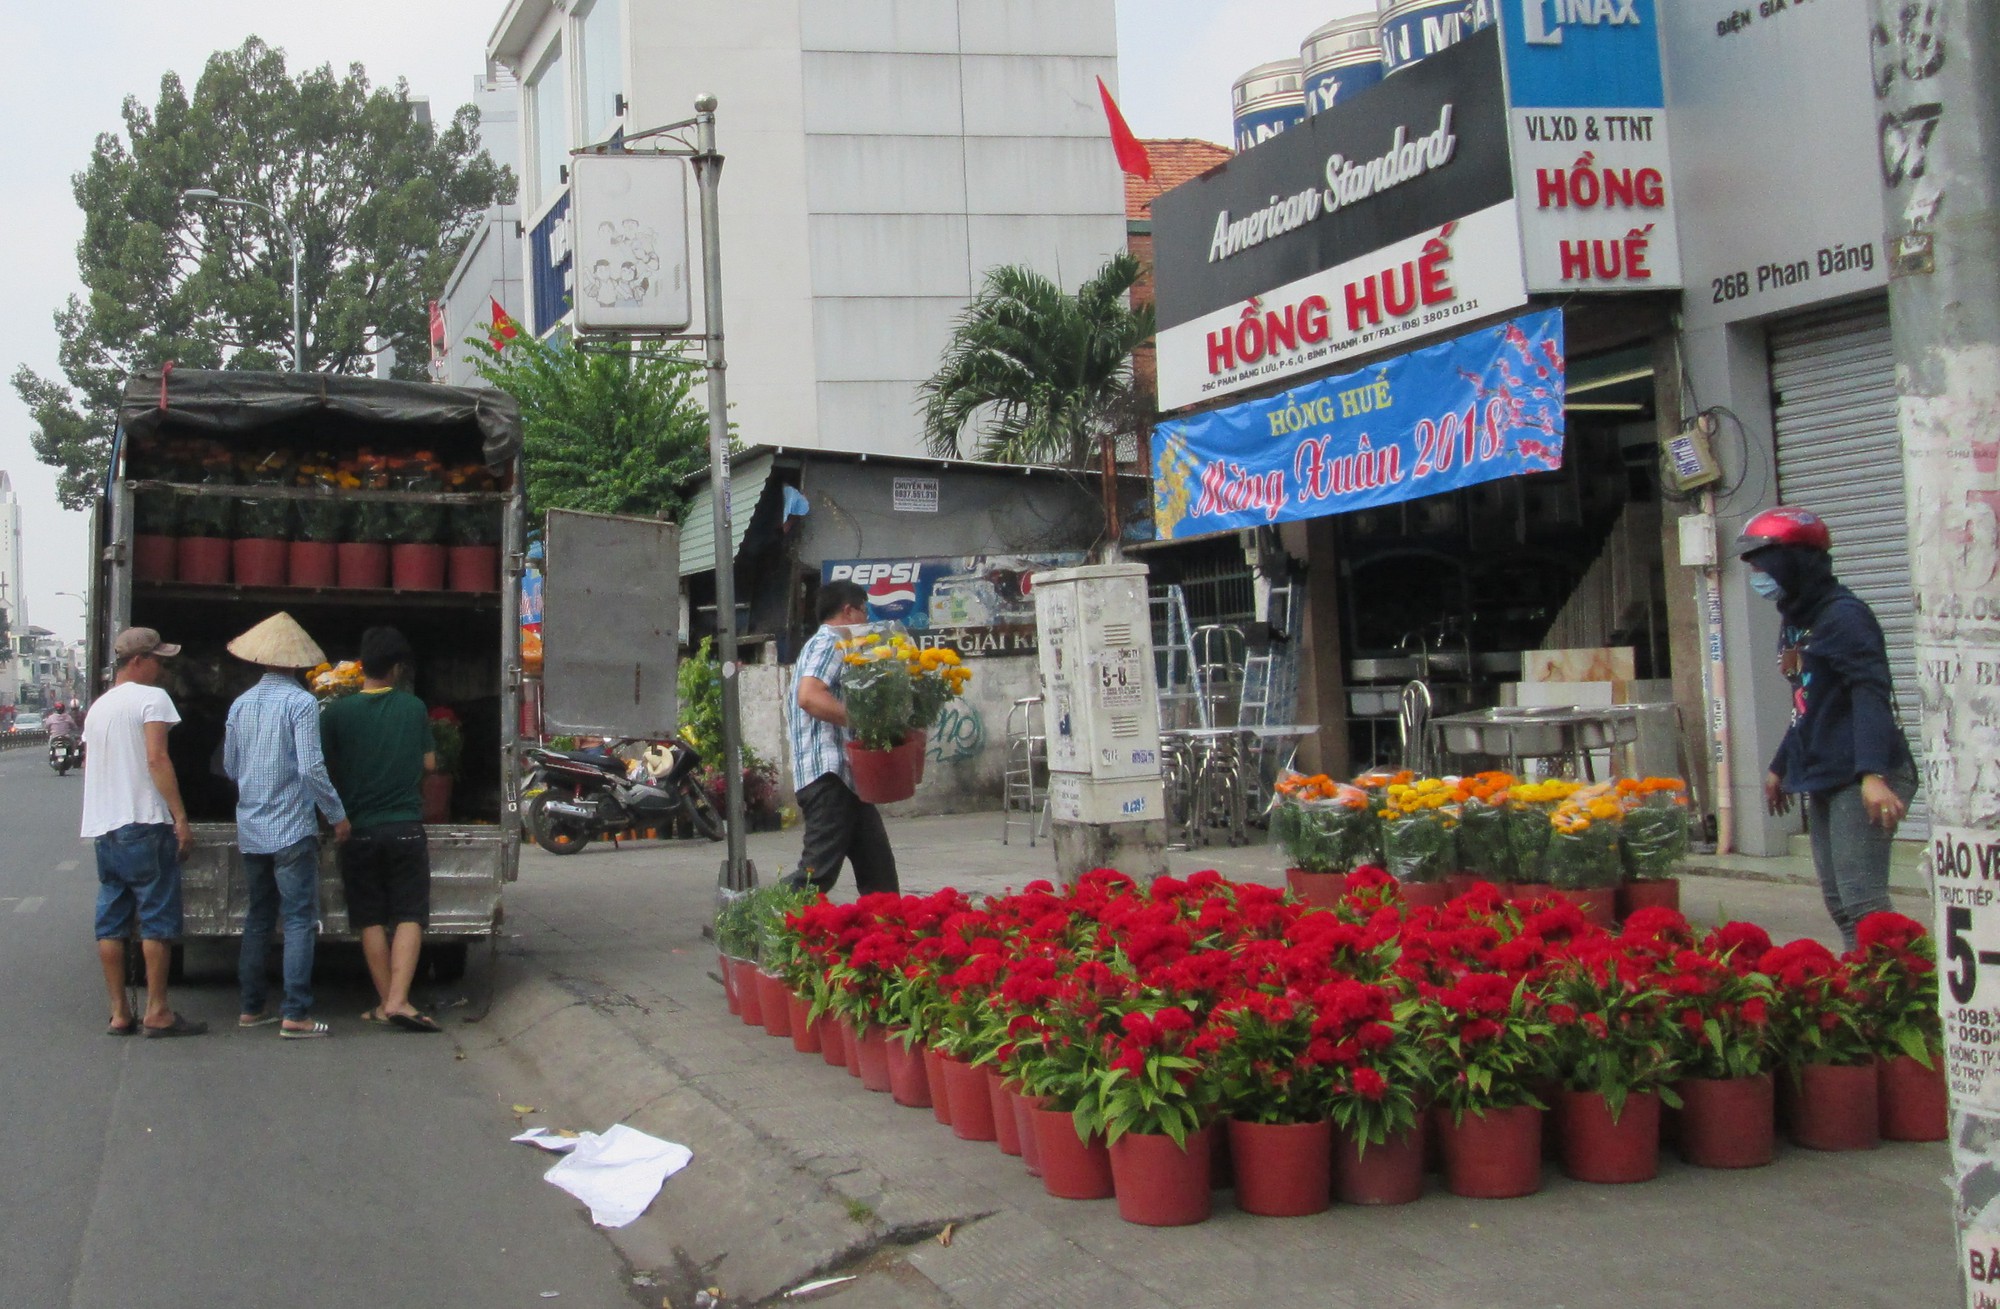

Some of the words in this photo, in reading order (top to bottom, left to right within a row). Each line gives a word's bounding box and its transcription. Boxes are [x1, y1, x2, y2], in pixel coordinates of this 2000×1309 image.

[1525, 115, 1578, 142] VLXD
[1584, 117, 1601, 141] &
[1604, 115, 1654, 142] TTNT
[1208, 187, 1322, 264] American
[1323, 103, 1457, 211] Standard
[1536, 150, 1666, 209] HỒNG
[1559, 223, 1655, 281] HUẾ
[1712, 273, 1749, 304] 26B
[1757, 260, 1810, 293] Phan
[1817, 242, 1876, 278] Đăng
[1206, 296, 1333, 376] HỒNG
[1344, 221, 1459, 332] HUẾ
[1217, 373, 1238, 388] PHAN
[1402, 317, 1421, 331] (08)
[1422, 308, 1451, 326] 3803
[1451, 298, 1480, 316] 0131
[1267, 393, 1334, 437] HỒNG
[1338, 368, 1393, 419] HUẾ
[1294, 432, 1405, 503] Xuân
[1411, 395, 1503, 481] 2018
[831, 562, 921, 585] PEPSI
[957, 626, 1006, 652] GIẢI
[1935, 832, 1973, 879] BẢO
